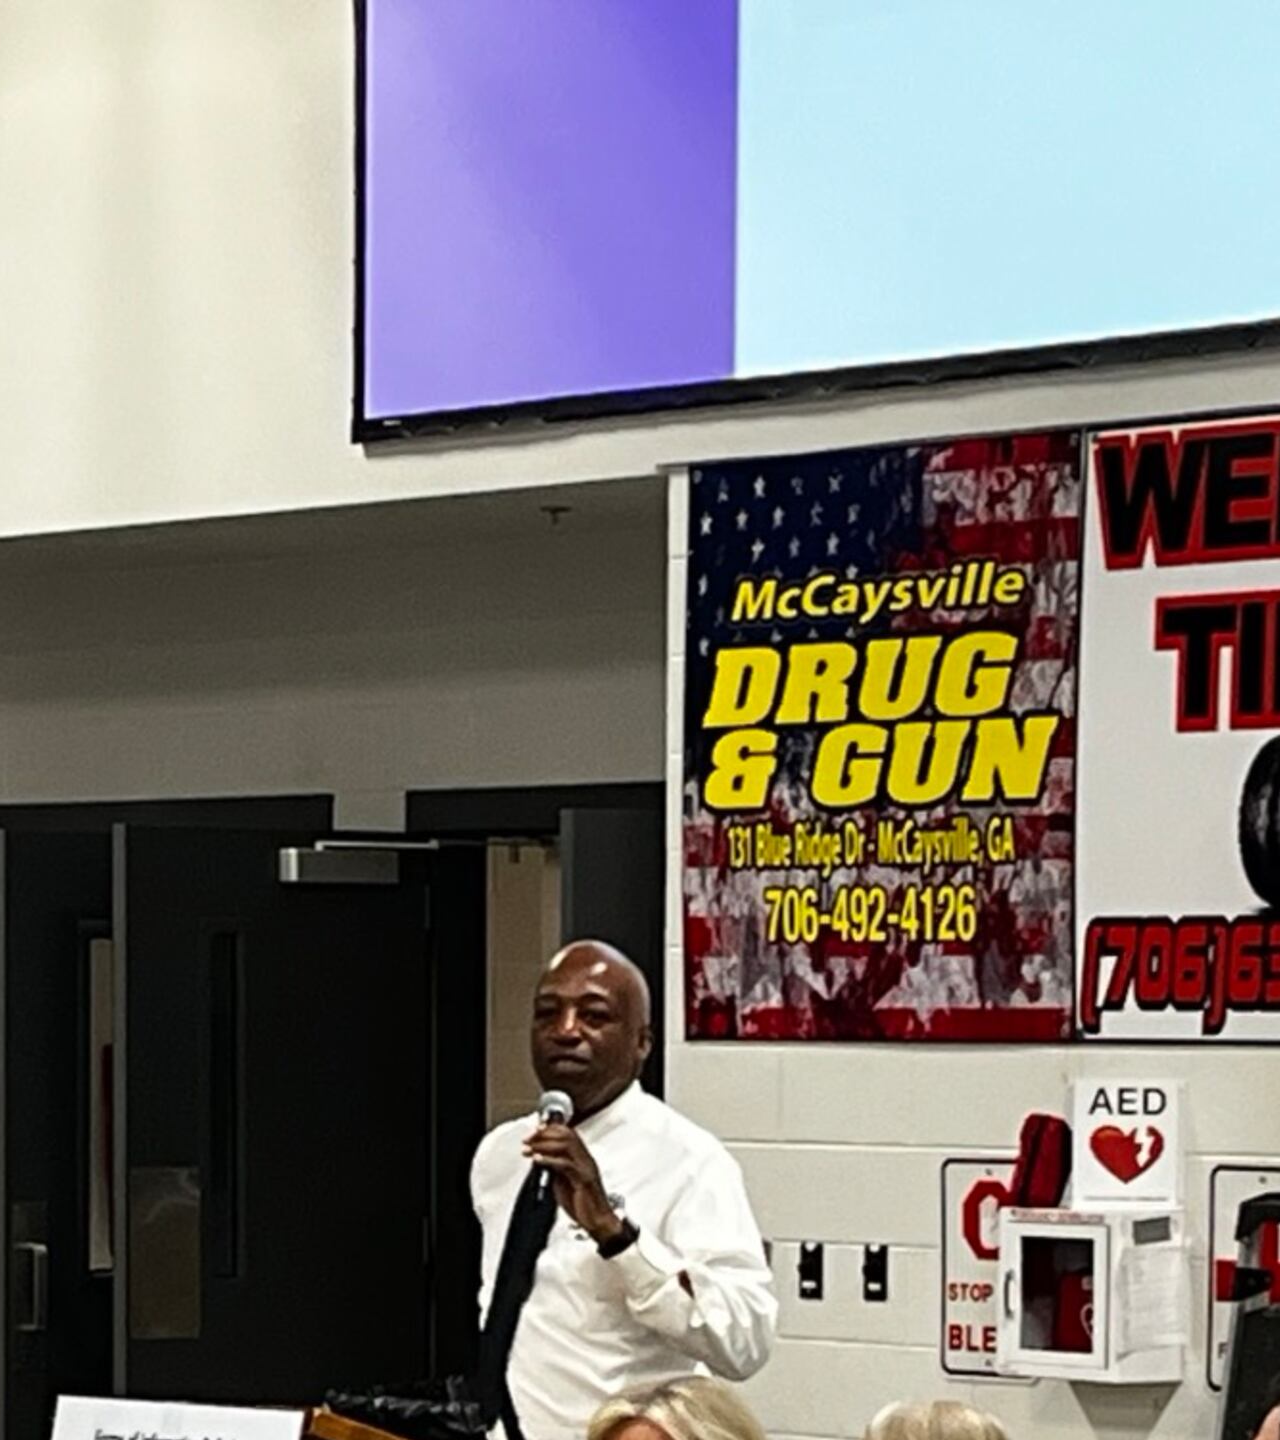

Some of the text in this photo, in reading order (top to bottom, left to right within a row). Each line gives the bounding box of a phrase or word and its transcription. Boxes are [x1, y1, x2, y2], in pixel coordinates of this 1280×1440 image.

[731, 561, 1025, 624] McCaysville
[702, 630, 1019, 730] DRUG
[704, 715, 1060, 809] & GUN
[728, 825, 752, 868] 131
[755, 821, 791, 868] Blue
[794, 820, 842, 878] Ridge
[844, 819, 866, 864] Dr
[877, 817, 985, 876] McCaysville,
[986, 816, 1016, 863] GA
[764, 885, 977, 943] 706-492-4126
[1087, 1087, 1167, 1115] AED
[948, 1282, 994, 1303] STOP
